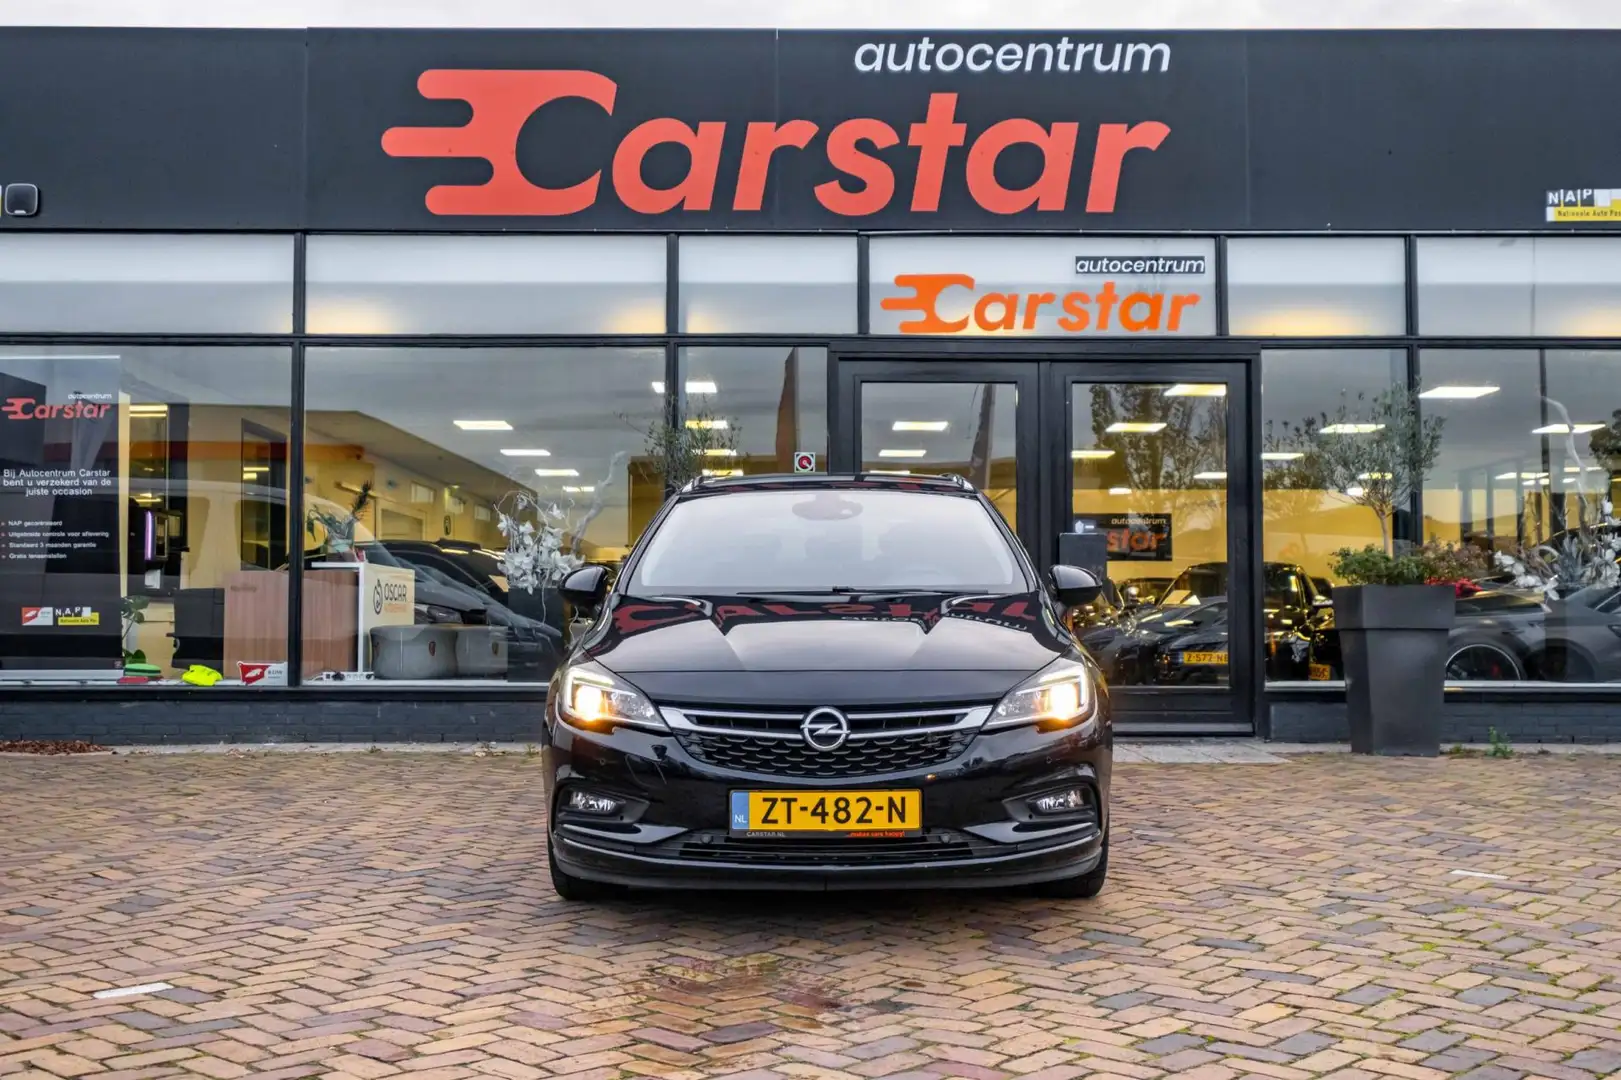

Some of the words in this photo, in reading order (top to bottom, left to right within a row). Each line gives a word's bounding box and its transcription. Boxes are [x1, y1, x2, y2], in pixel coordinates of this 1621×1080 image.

[854, 37, 1171, 74] autocentrum
[381, 68, 1171, 216] Carstar
[1076, 257, 1205, 273] autocentrum
[880, 274, 1200, 333] Carstar
[1, 398, 111, 419] Carstar
[3, 469, 16, 479] Bij
[20, 469, 76, 478] Autocentrum
[79, 469, 111, 478] Carstar
[3, 478, 24, 487] bent
[36, 478, 79, 487] verzekerd
[101, 478, 112, 487] de
[25, 487, 49, 497] juiste
[52, 487, 92, 496] occasion
[383, 583, 407, 602] OSCAR
[734, 815, 747, 823] NL
[761, 796, 906, 825] ZT-482-N
